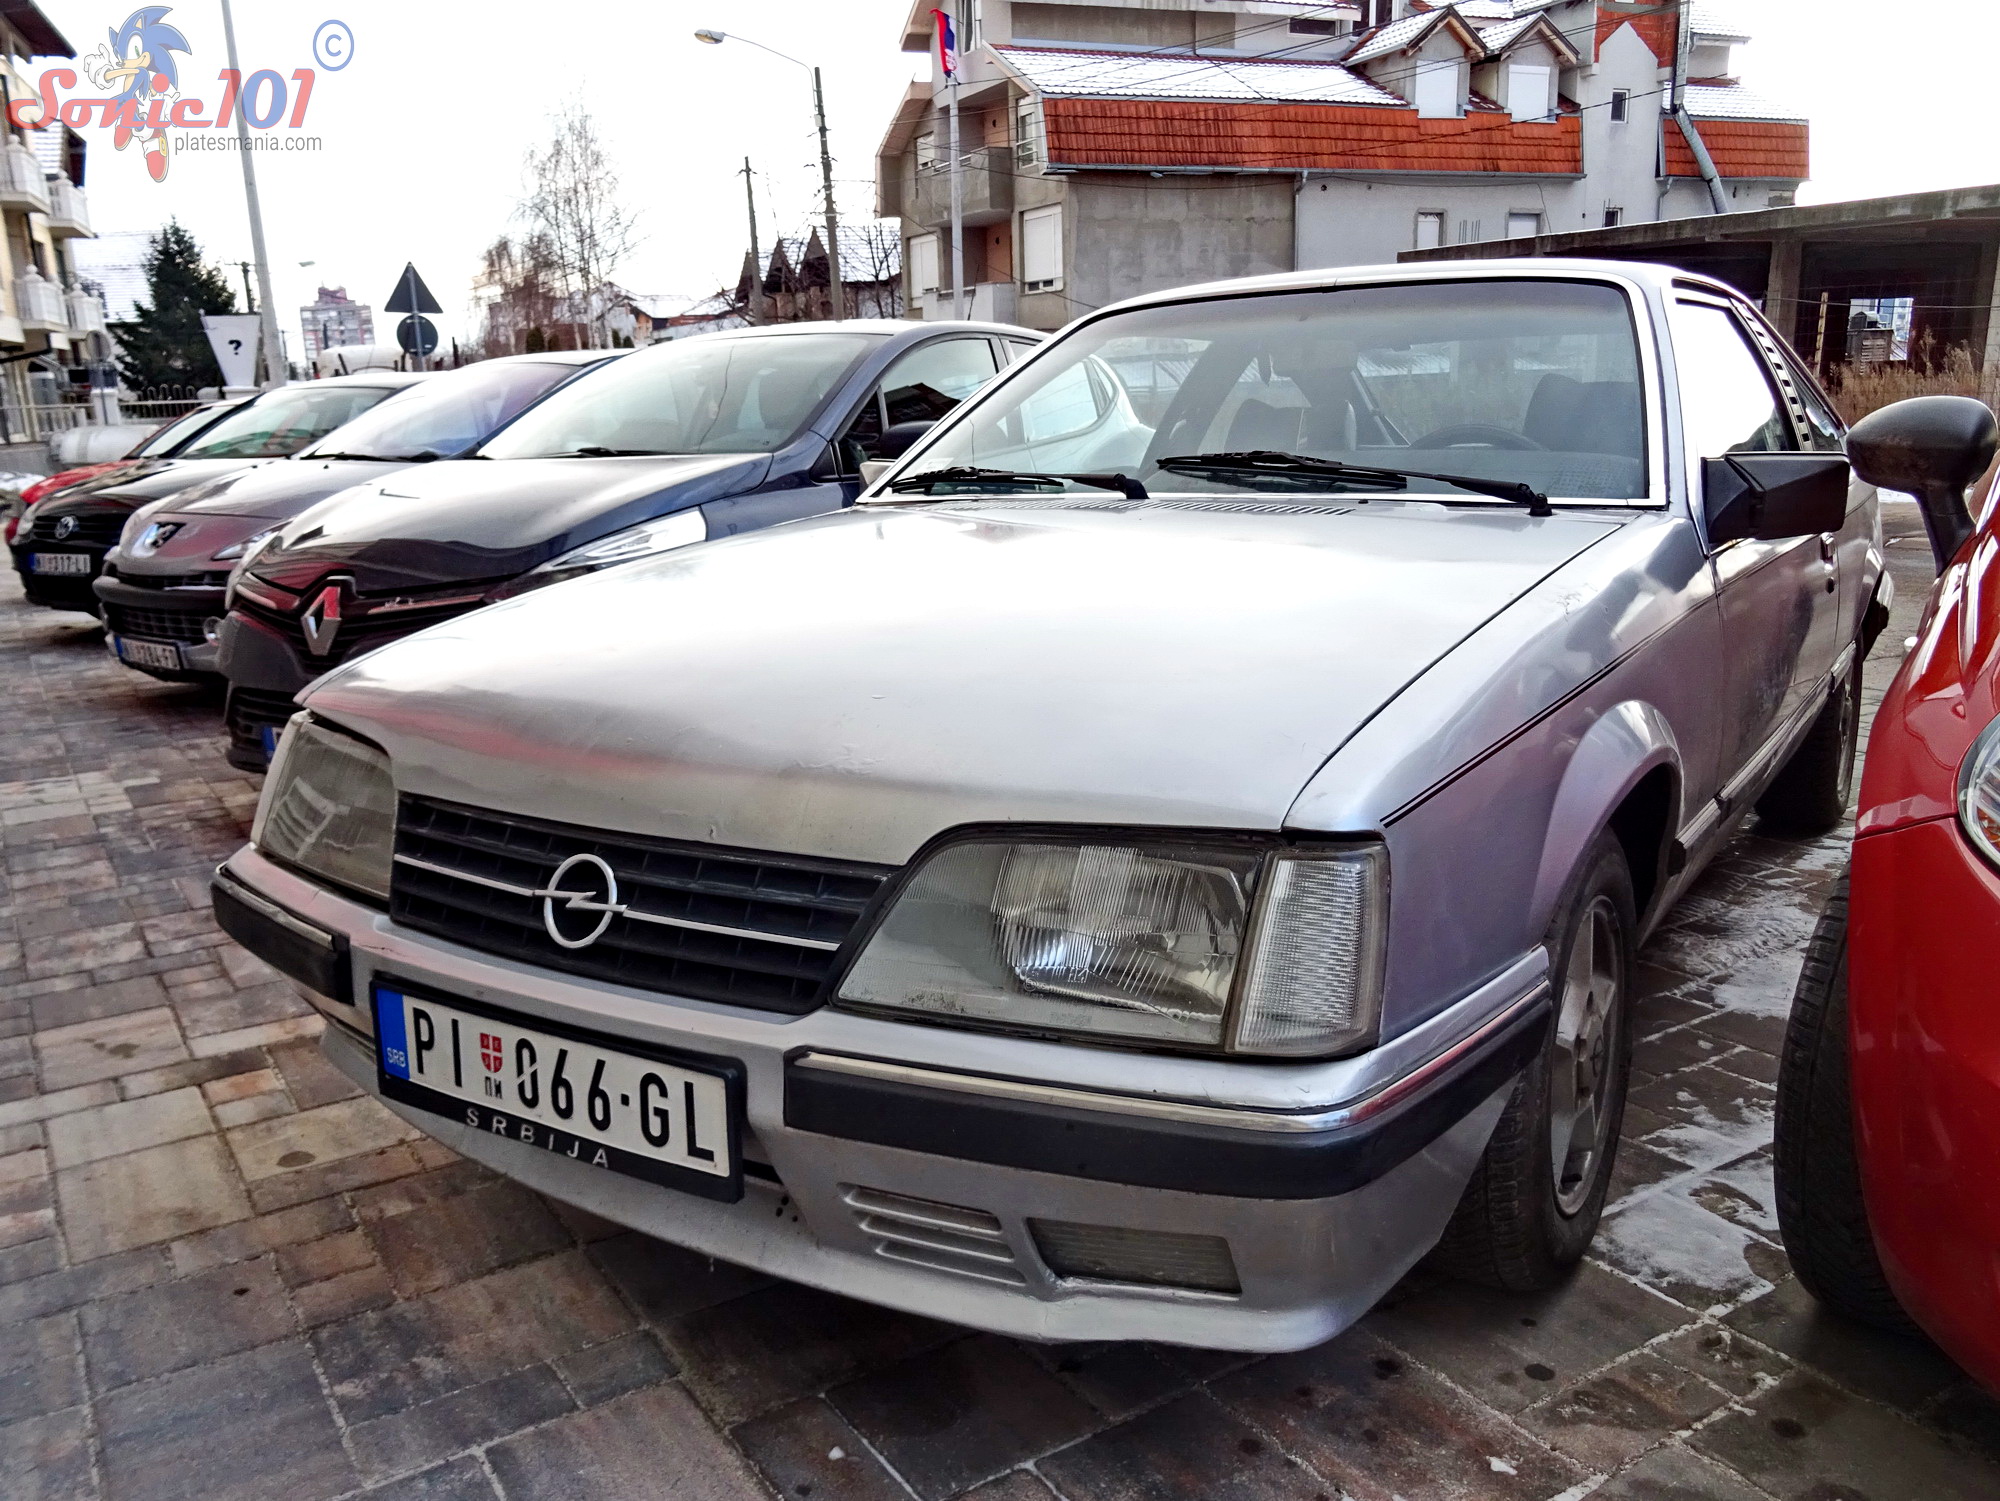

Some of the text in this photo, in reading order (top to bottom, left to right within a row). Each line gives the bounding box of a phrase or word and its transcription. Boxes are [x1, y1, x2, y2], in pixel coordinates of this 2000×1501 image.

[386, 1047, 407, 1068] SRB
[412, 1006, 463, 1088] PI
[465, 1106, 609, 1169] SRBIJA
